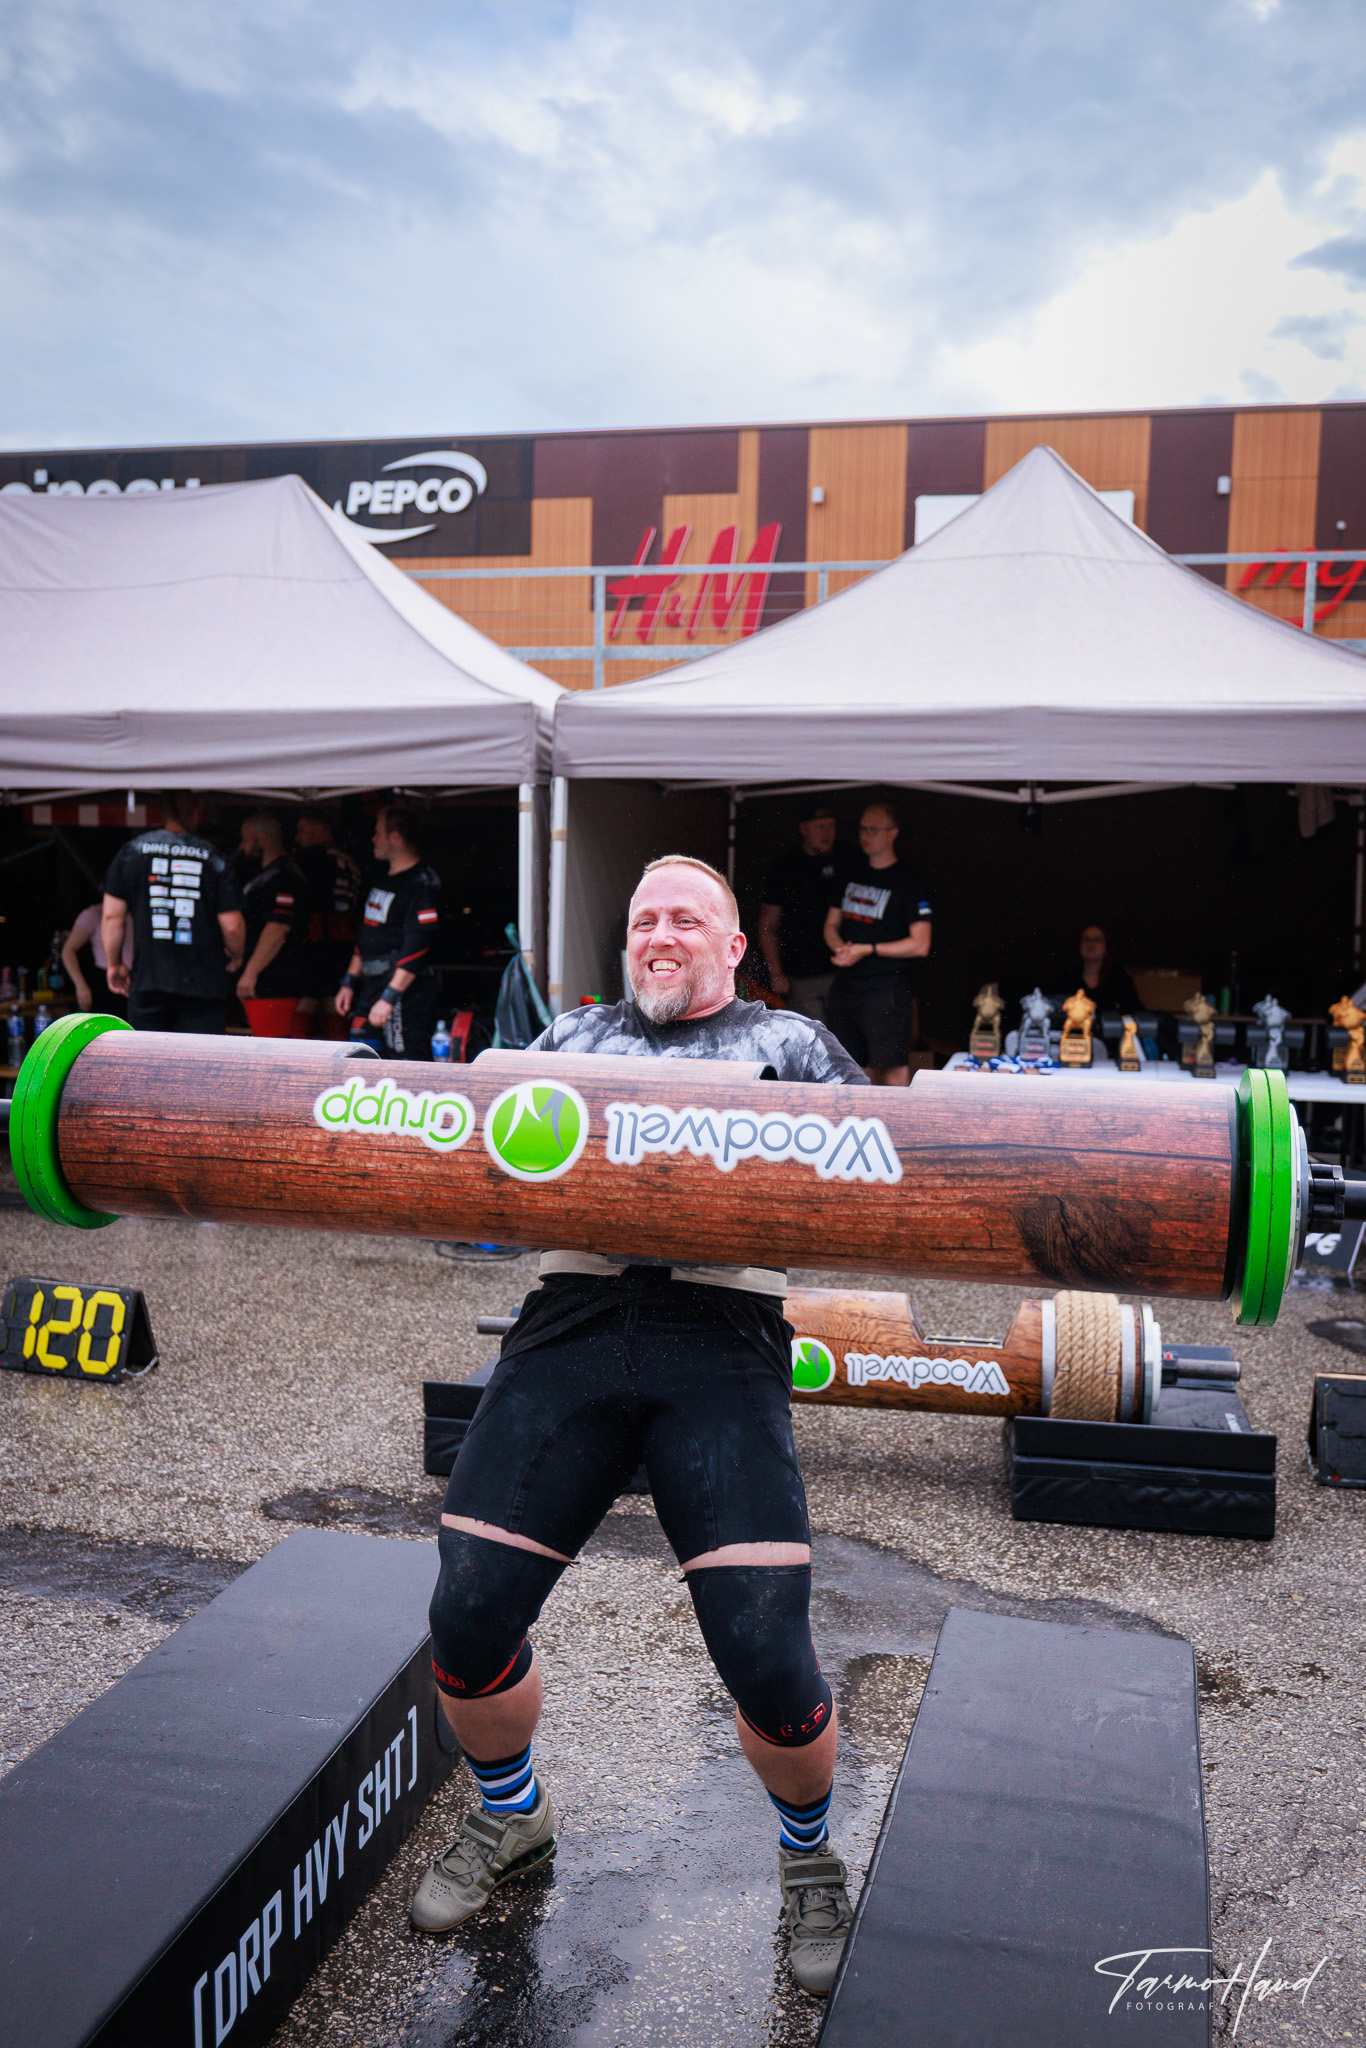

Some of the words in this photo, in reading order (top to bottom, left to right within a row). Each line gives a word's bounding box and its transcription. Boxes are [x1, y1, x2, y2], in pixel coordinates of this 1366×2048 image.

[346, 478, 473, 515] PEPCO
[606, 521, 782, 643] H&M
[321, 1083, 468, 1143] Grupp
[613, 1110, 894, 1174] Woodwell
[23, 1285, 126, 1375] 120
[848, 1357, 1006, 1392] Woodwell
[293, 1800, 349, 1940] HVY
